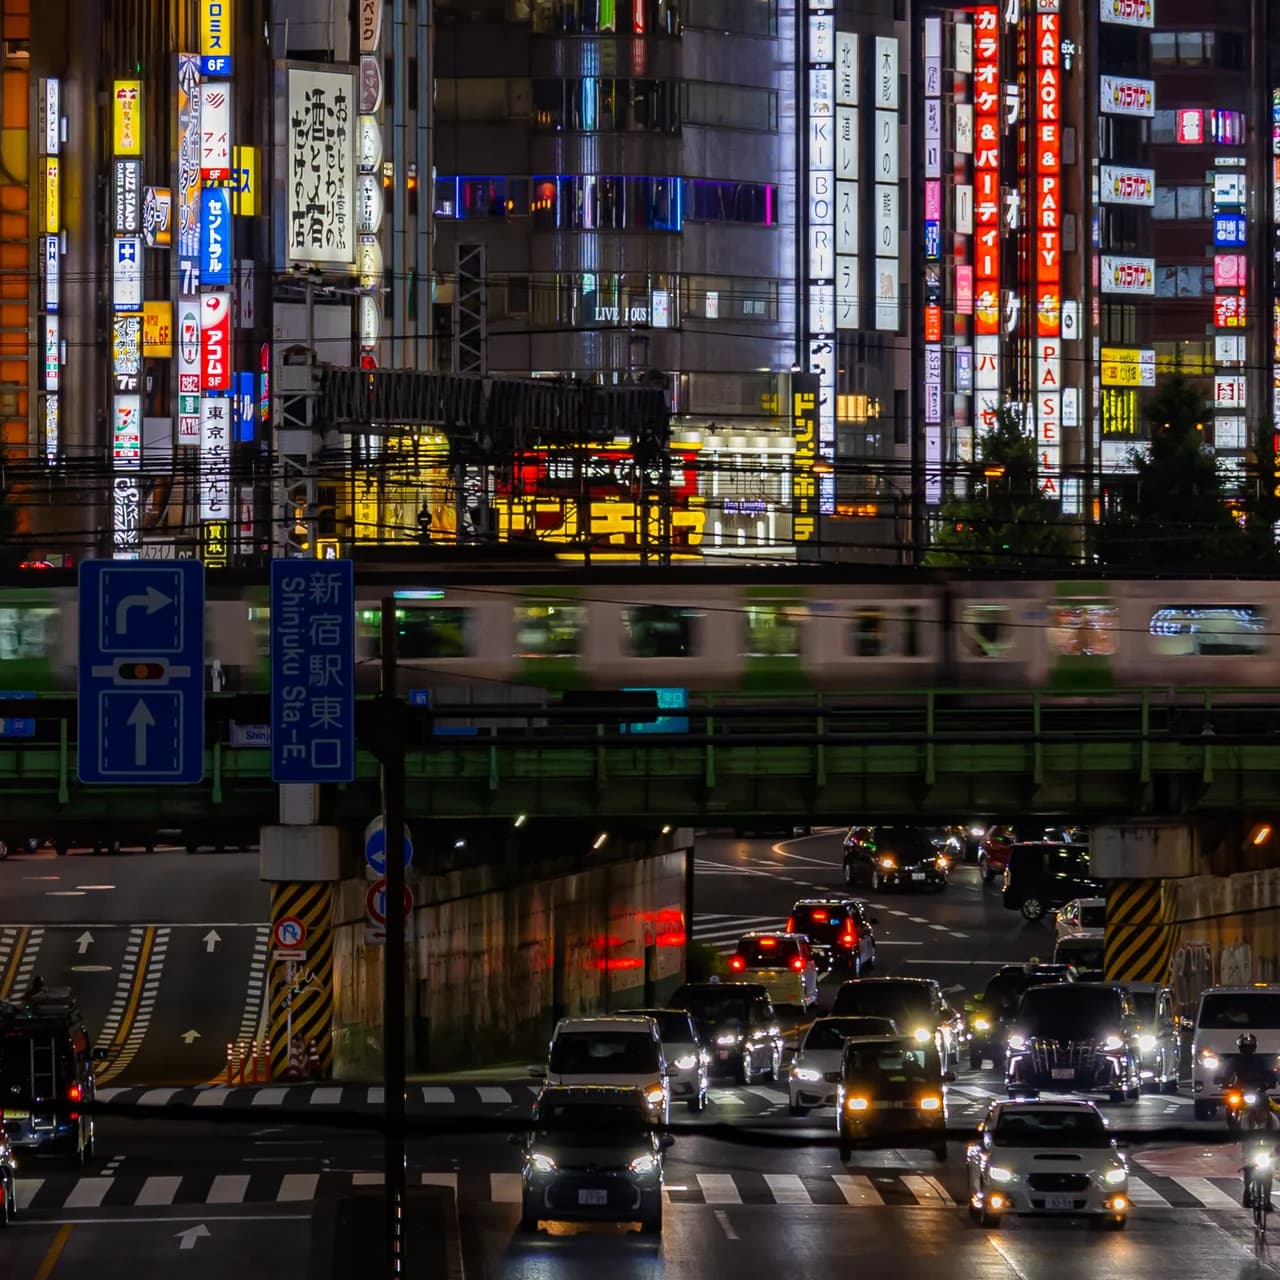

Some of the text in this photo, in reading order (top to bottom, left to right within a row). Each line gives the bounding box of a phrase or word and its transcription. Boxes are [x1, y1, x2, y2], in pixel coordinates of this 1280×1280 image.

[1039, 0, 1057, 8] OK
[207, 59, 225, 70] 6F
[1041, 14, 1056, 266] KARAOKE & PARTY
[209, 170, 221, 180] 5F
[815, 123, 828, 273] KIBORI
[207, 199, 223, 274] セントラル
[180, 260, 200, 296] 7F
[595, 307, 620, 321] LIVE
[206, 331, 223, 376] アコム
[117, 375, 138, 390] 7F
[208, 377, 222, 387] 3F
[1041, 346, 1057, 493] PASELA
[279, 576, 306, 676] Shinjuku
[309, 570, 343, 769] 新宿駅東口
